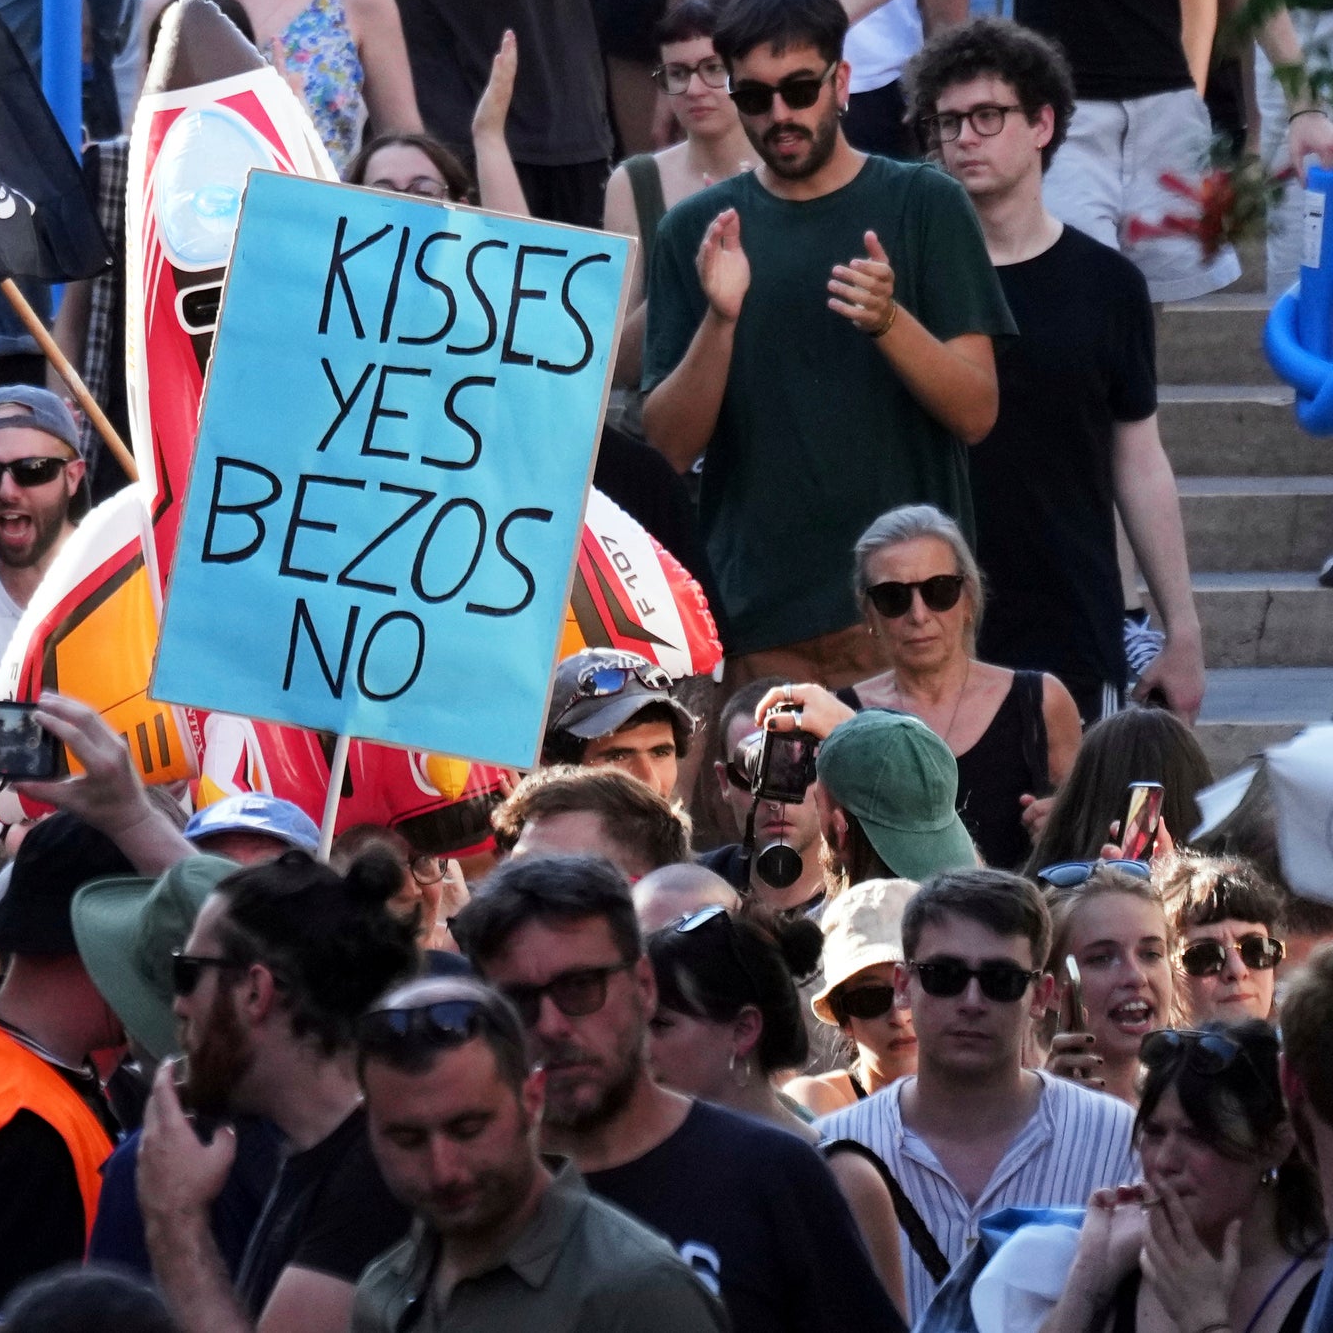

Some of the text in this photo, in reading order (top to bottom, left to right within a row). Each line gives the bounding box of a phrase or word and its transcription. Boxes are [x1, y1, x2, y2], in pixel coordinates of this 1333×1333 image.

[318, 216, 612, 376] KISSES
[316, 357, 497, 469] YES
[200, 456, 554, 616] BEZOS
[600, 535, 638, 590] 107
[282, 598, 427, 703] NO
[186, 706, 206, 757] NTEX
